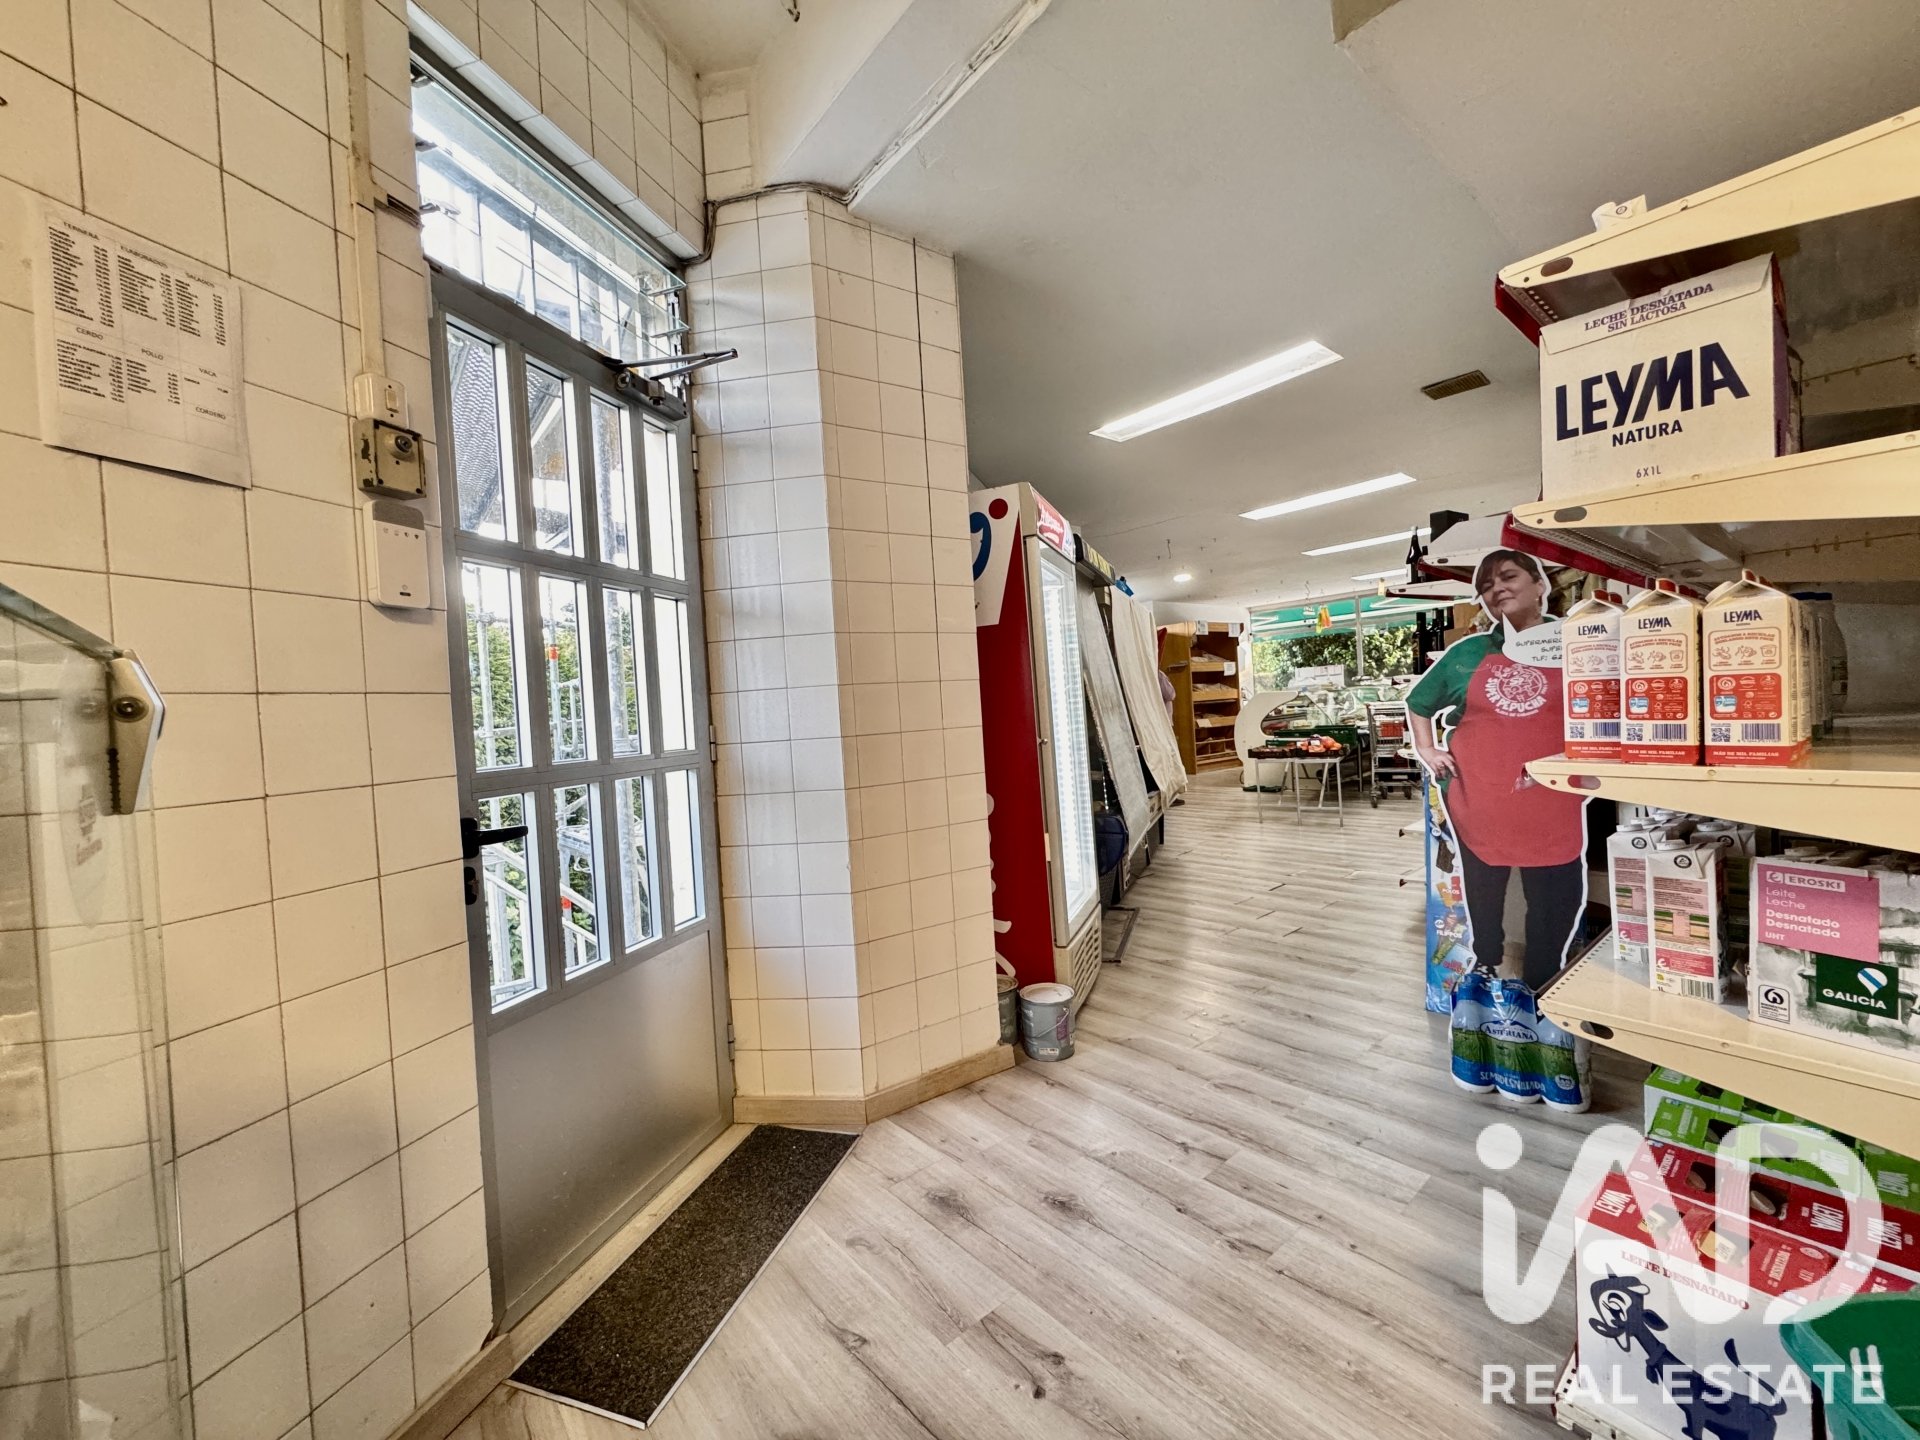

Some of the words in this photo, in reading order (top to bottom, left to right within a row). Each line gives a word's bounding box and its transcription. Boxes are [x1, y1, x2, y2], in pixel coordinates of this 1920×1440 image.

[1584, 309, 1628, 332] LECHE
[1630, 283, 1714, 316] DESNATADA
[1607, 318, 1628, 333] SIN
[1630, 301, 1687, 326] LACTOSA
[76, 326, 104, 341] CERDO
[141, 348, 164, 361] POLLO
[198, 367, 217, 378] VACA
[1555, 342, 1750, 442] LEYMA
[195, 406, 226, 420] CORDERO
[1612, 419, 1684, 447] NATURA
[1636, 465, 1662, 479] 6X1L
[1638, 616, 1672, 630] LEYMA
[1724, 609, 1762, 624] LEYMA
[1578, 624, 1608, 636] LEYMA
[1484, 677, 1501, 703] SUPER
[1496, 696, 1547, 712] PEPUCHA
[1788, 876, 1842, 890] EROSKI
[1766, 887, 1797, 899] Leite
[1766, 898, 1806, 910] Leche
[1766, 908, 1840, 928] Desnatado
[1766, 918, 1840, 938] Desnatada
[1765, 932, 1785, 941] UHT
[1822, 988, 1887, 1010] GALICIA
[1594, 1189, 1632, 1218] LEYMA
[1621, 1250, 1660, 1274] LEITE
[1662, 1266, 1750, 1310] DESNATADO
